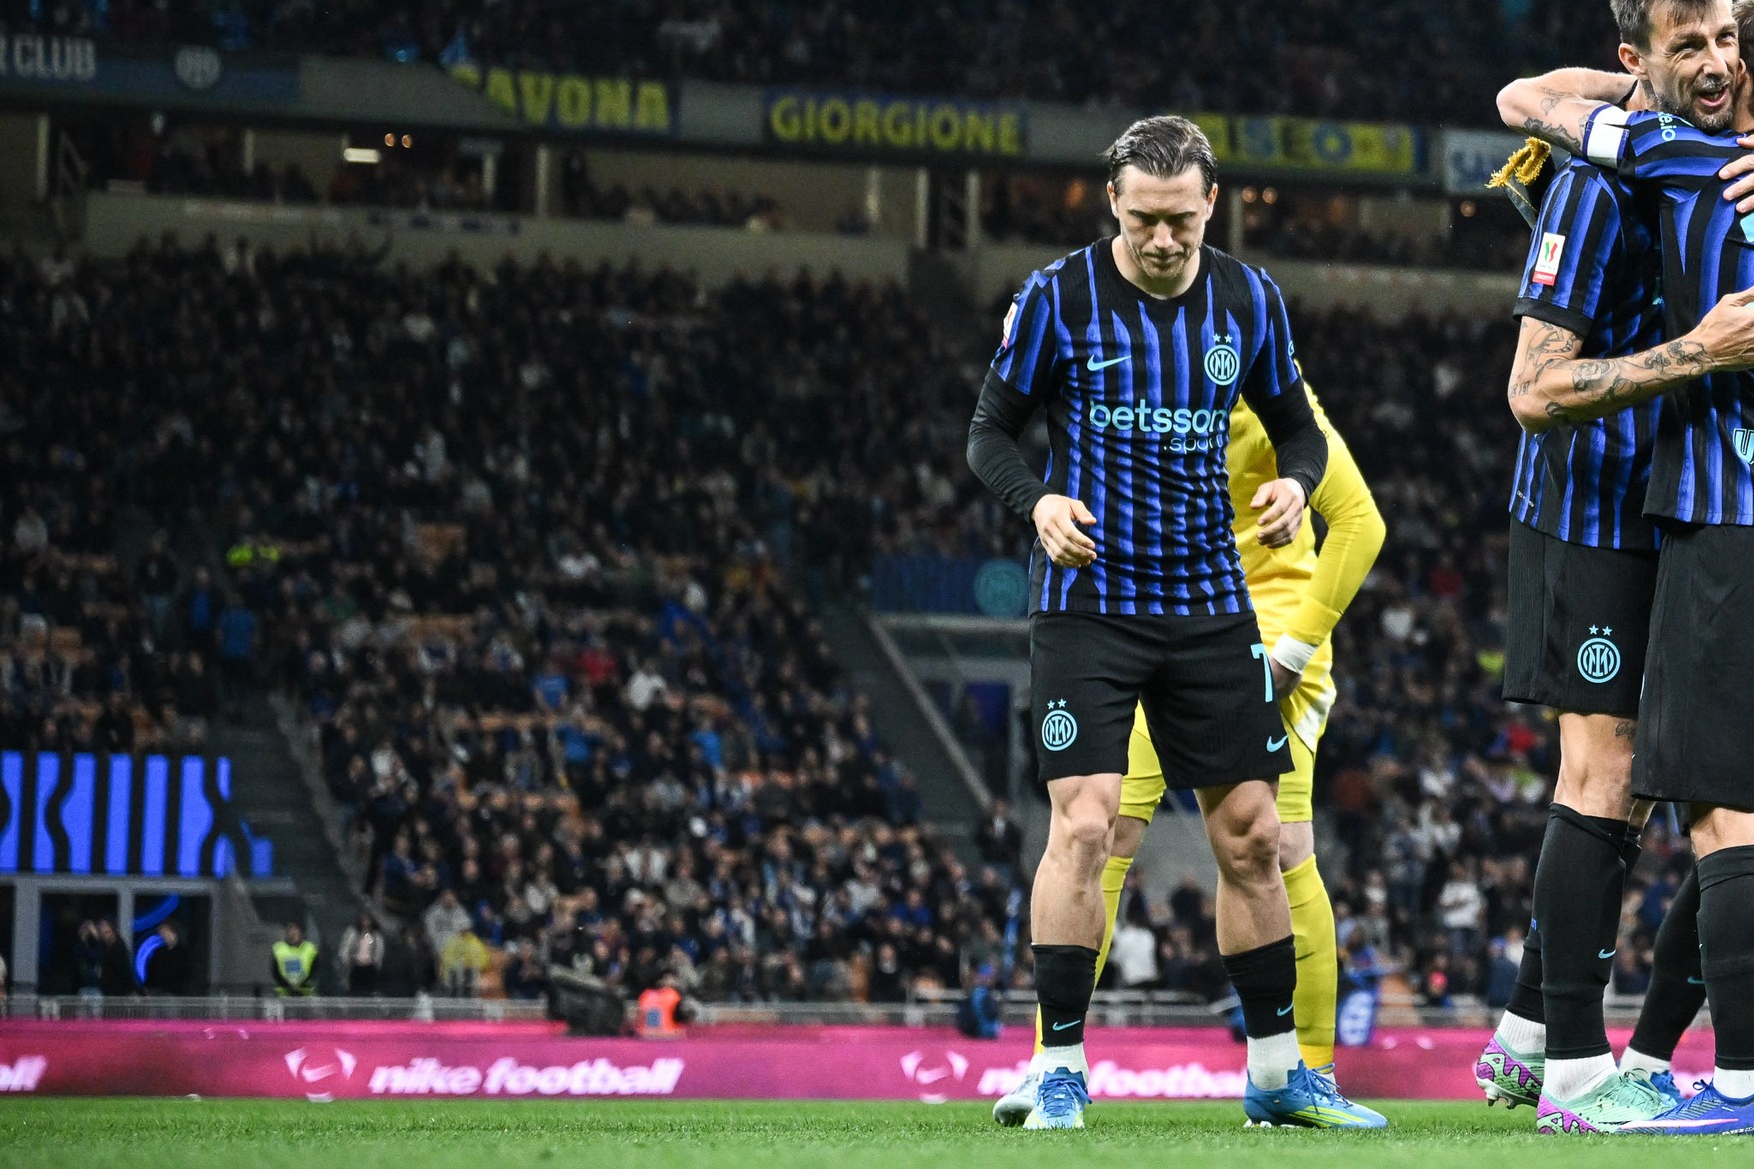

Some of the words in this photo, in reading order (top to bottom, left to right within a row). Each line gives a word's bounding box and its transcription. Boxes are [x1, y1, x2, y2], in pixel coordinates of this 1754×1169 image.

[13, 33, 97, 81] CLUB
[452, 64, 670, 130] AVONA
[769, 94, 1021, 157] GIORGIONE
[1088, 397, 1228, 434] betsson
[1250, 642, 1273, 703] 7
[367, 1057, 483, 1095] nike
[483, 1057, 686, 1095] football
